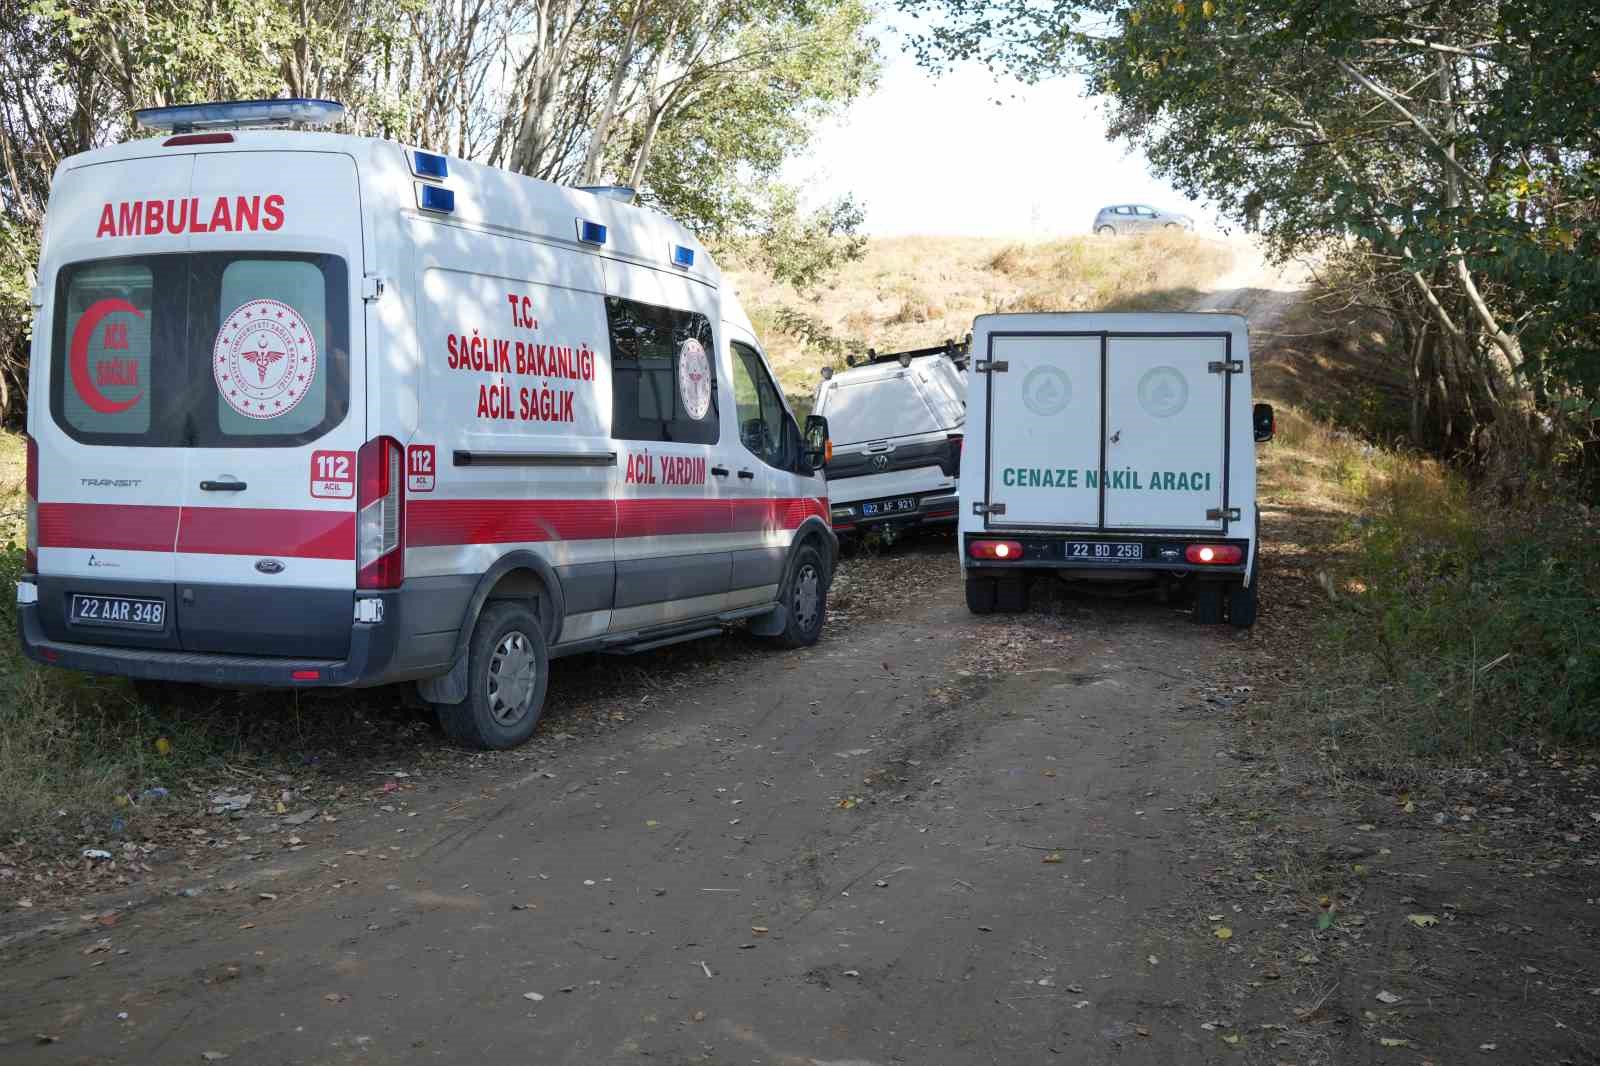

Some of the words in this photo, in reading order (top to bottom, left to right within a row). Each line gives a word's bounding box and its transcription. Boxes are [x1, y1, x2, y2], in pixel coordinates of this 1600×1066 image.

[96, 194, 285, 238] AMBULANS
[508, 294, 539, 329] T.C.
[447, 328, 512, 374] SAĞLIK
[516, 342, 596, 382] BAKANLIĞI
[477, 377, 515, 420] ACİL
[520, 381, 574, 423] SAĞLIK
[317, 455, 350, 479] 112
[411, 449, 432, 472] 112
[625, 447, 656, 485] ACİL
[660, 455, 706, 486] YARDIM
[79, 478, 143, 488] TRANSIT
[1003, 467, 1078, 489] CENAZE
[1150, 471, 1211, 491] ARACI
[869, 503, 879, 512] 22
[1073, 543, 1089, 556] 22
[1095, 544, 1110, 557] BD
[1117, 545, 1140, 557] 258
[80, 599, 99, 618] 22
[102, 600, 131, 621] AAR
[133, 603, 162, 623] 348
